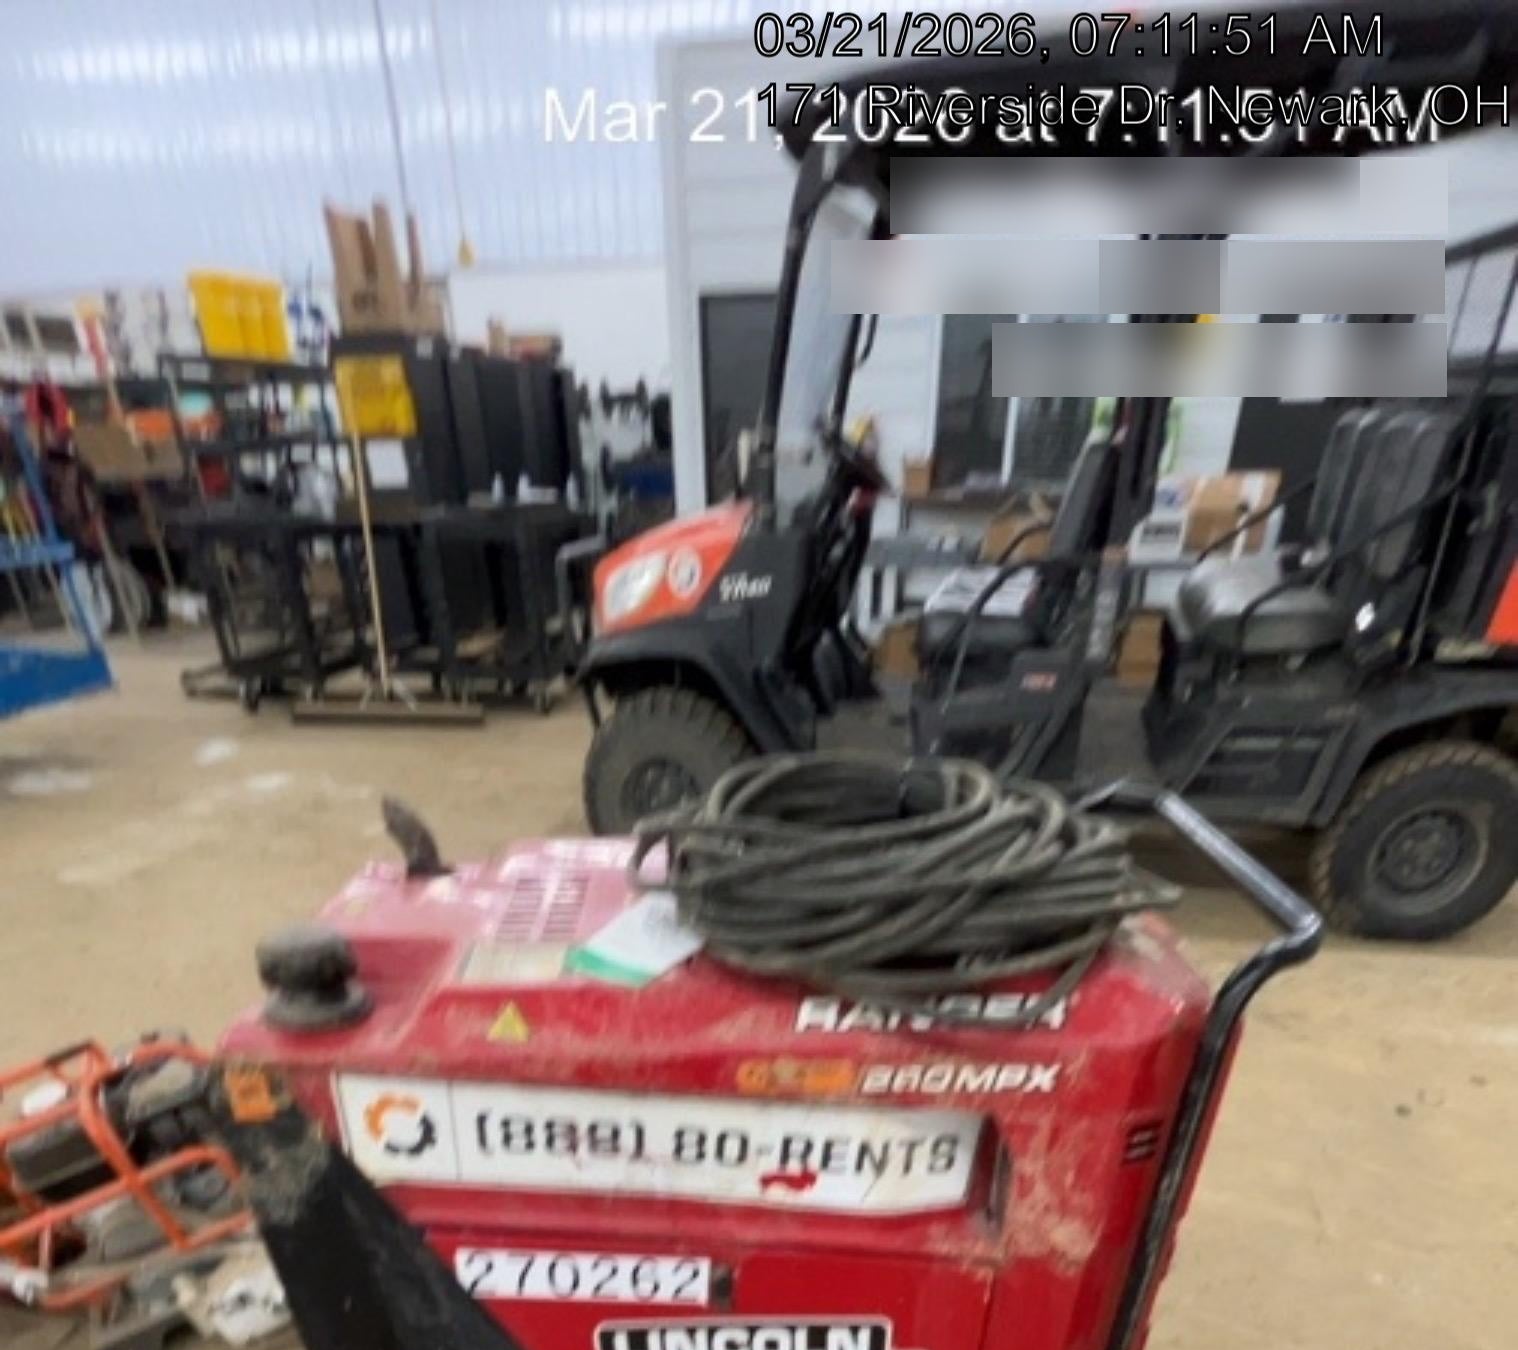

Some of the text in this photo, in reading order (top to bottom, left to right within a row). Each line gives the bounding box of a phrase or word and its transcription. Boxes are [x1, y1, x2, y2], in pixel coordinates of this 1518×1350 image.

[475, 1111, 961, 1176] (888) 80-RENTS
[464, 1252, 703, 1301] 270262
